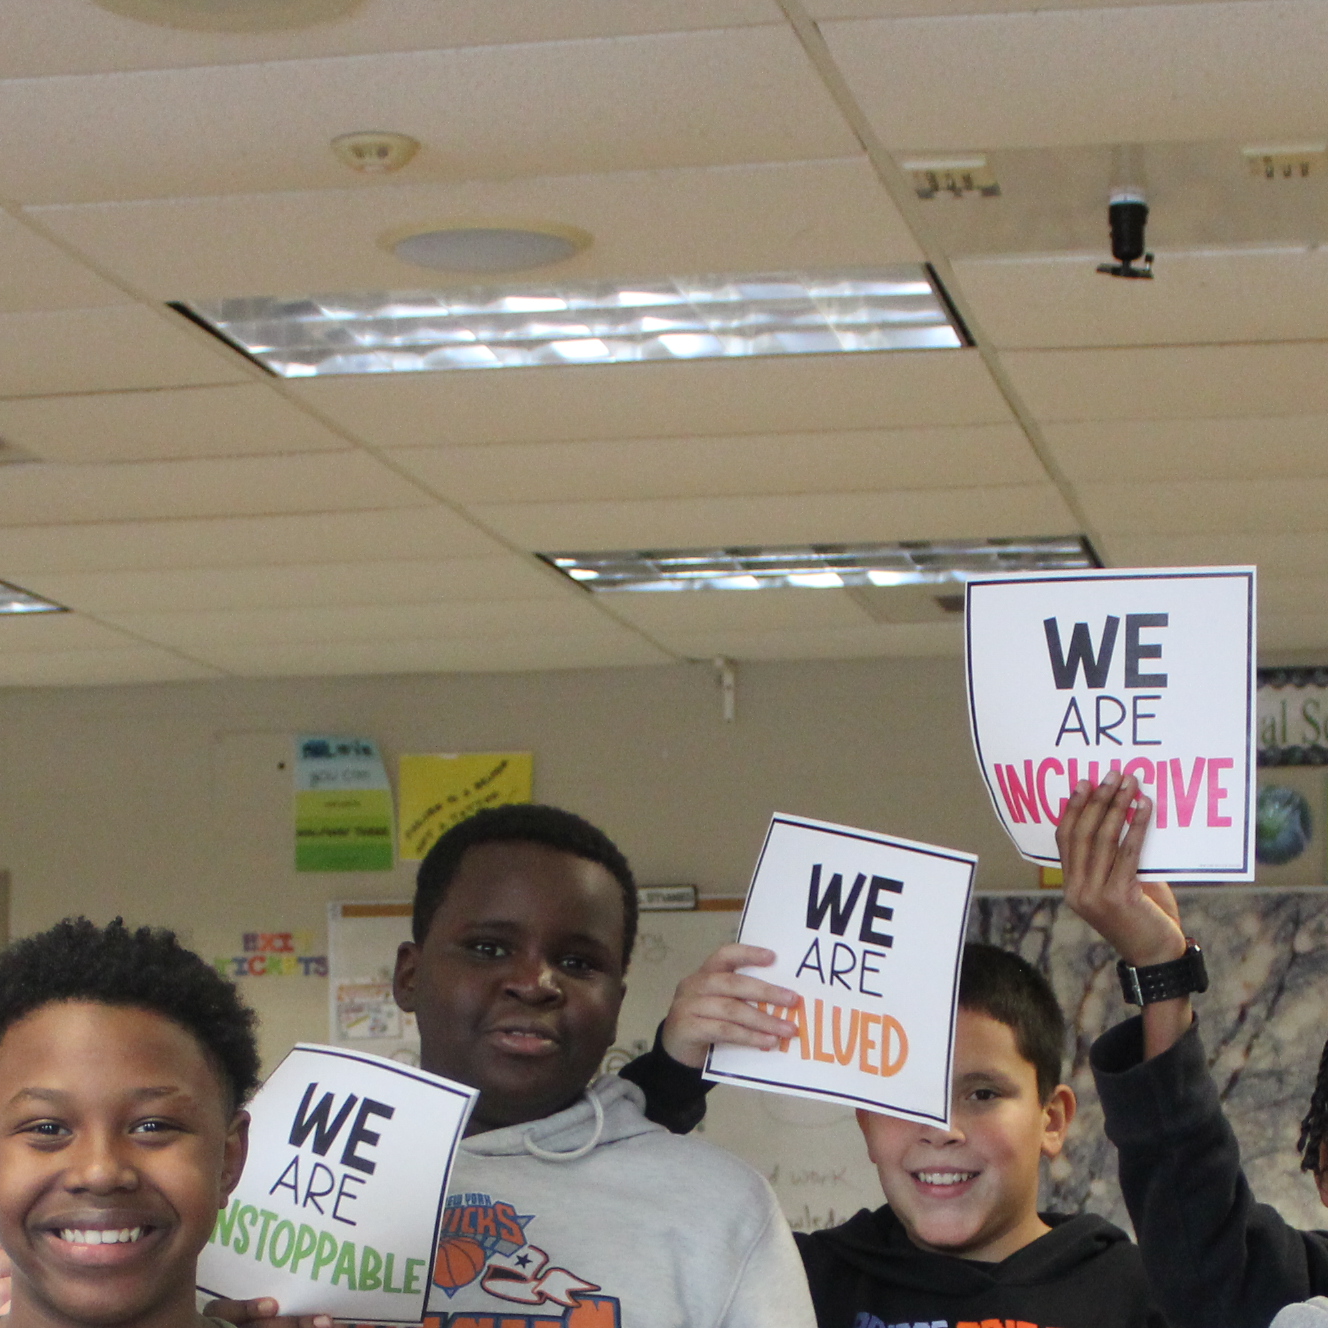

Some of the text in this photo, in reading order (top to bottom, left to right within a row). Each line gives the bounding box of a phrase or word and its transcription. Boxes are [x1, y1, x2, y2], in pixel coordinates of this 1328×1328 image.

[1043, 613, 1169, 689] WE
[1056, 695, 1162, 746] ARE
[994, 756, 1234, 828] INCSIVE
[806, 863, 904, 948] WE
[796, 938, 887, 997] ARE
[289, 1082, 395, 1175] WE
[269, 1155, 366, 1226] ARE
[208, 1198, 425, 1294] NSTOPPABLE
